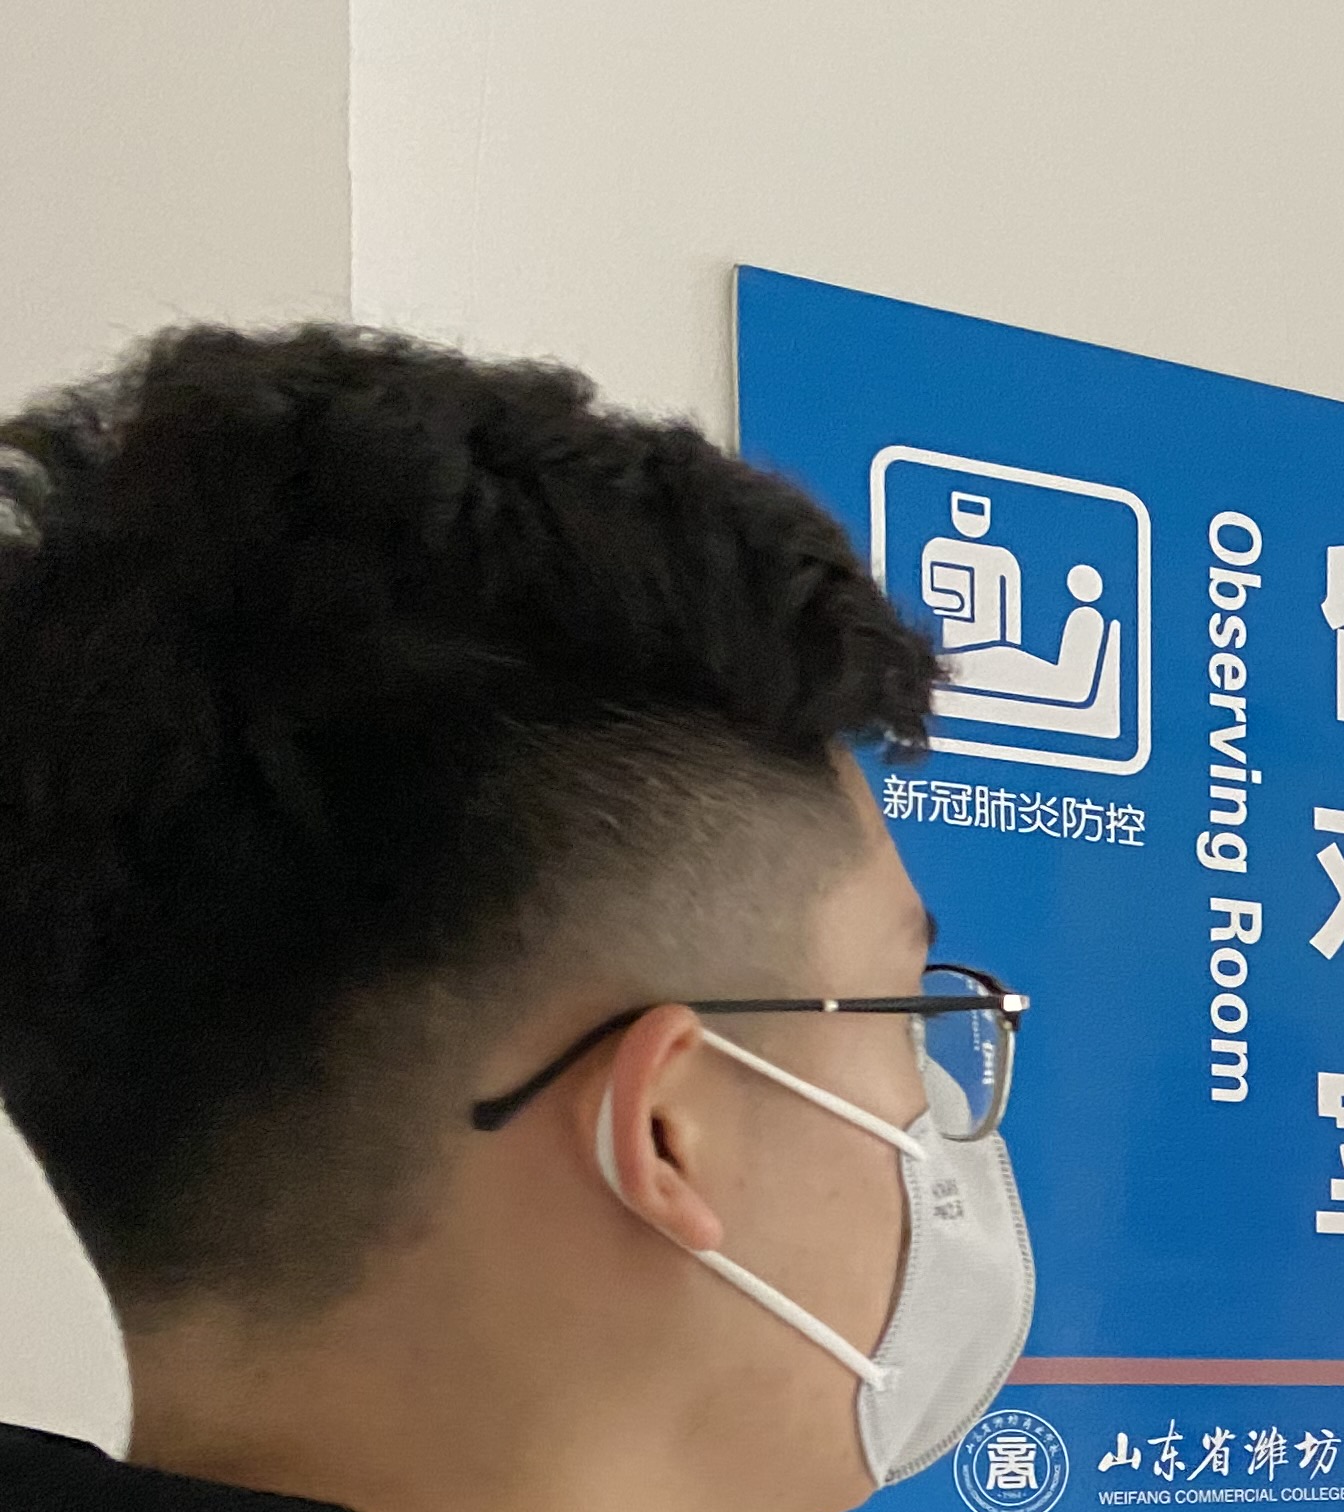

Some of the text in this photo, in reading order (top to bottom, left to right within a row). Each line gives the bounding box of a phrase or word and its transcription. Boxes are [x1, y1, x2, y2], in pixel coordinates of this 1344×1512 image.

[882, 774, 1146, 847] 新冠肺炎防控
[1197, 510, 1263, 1104] Observing Room
[1098, 1490, 1172, 1505] WEIFANG
[1174, 1488, 1278, 1505] COMMERCIAL
